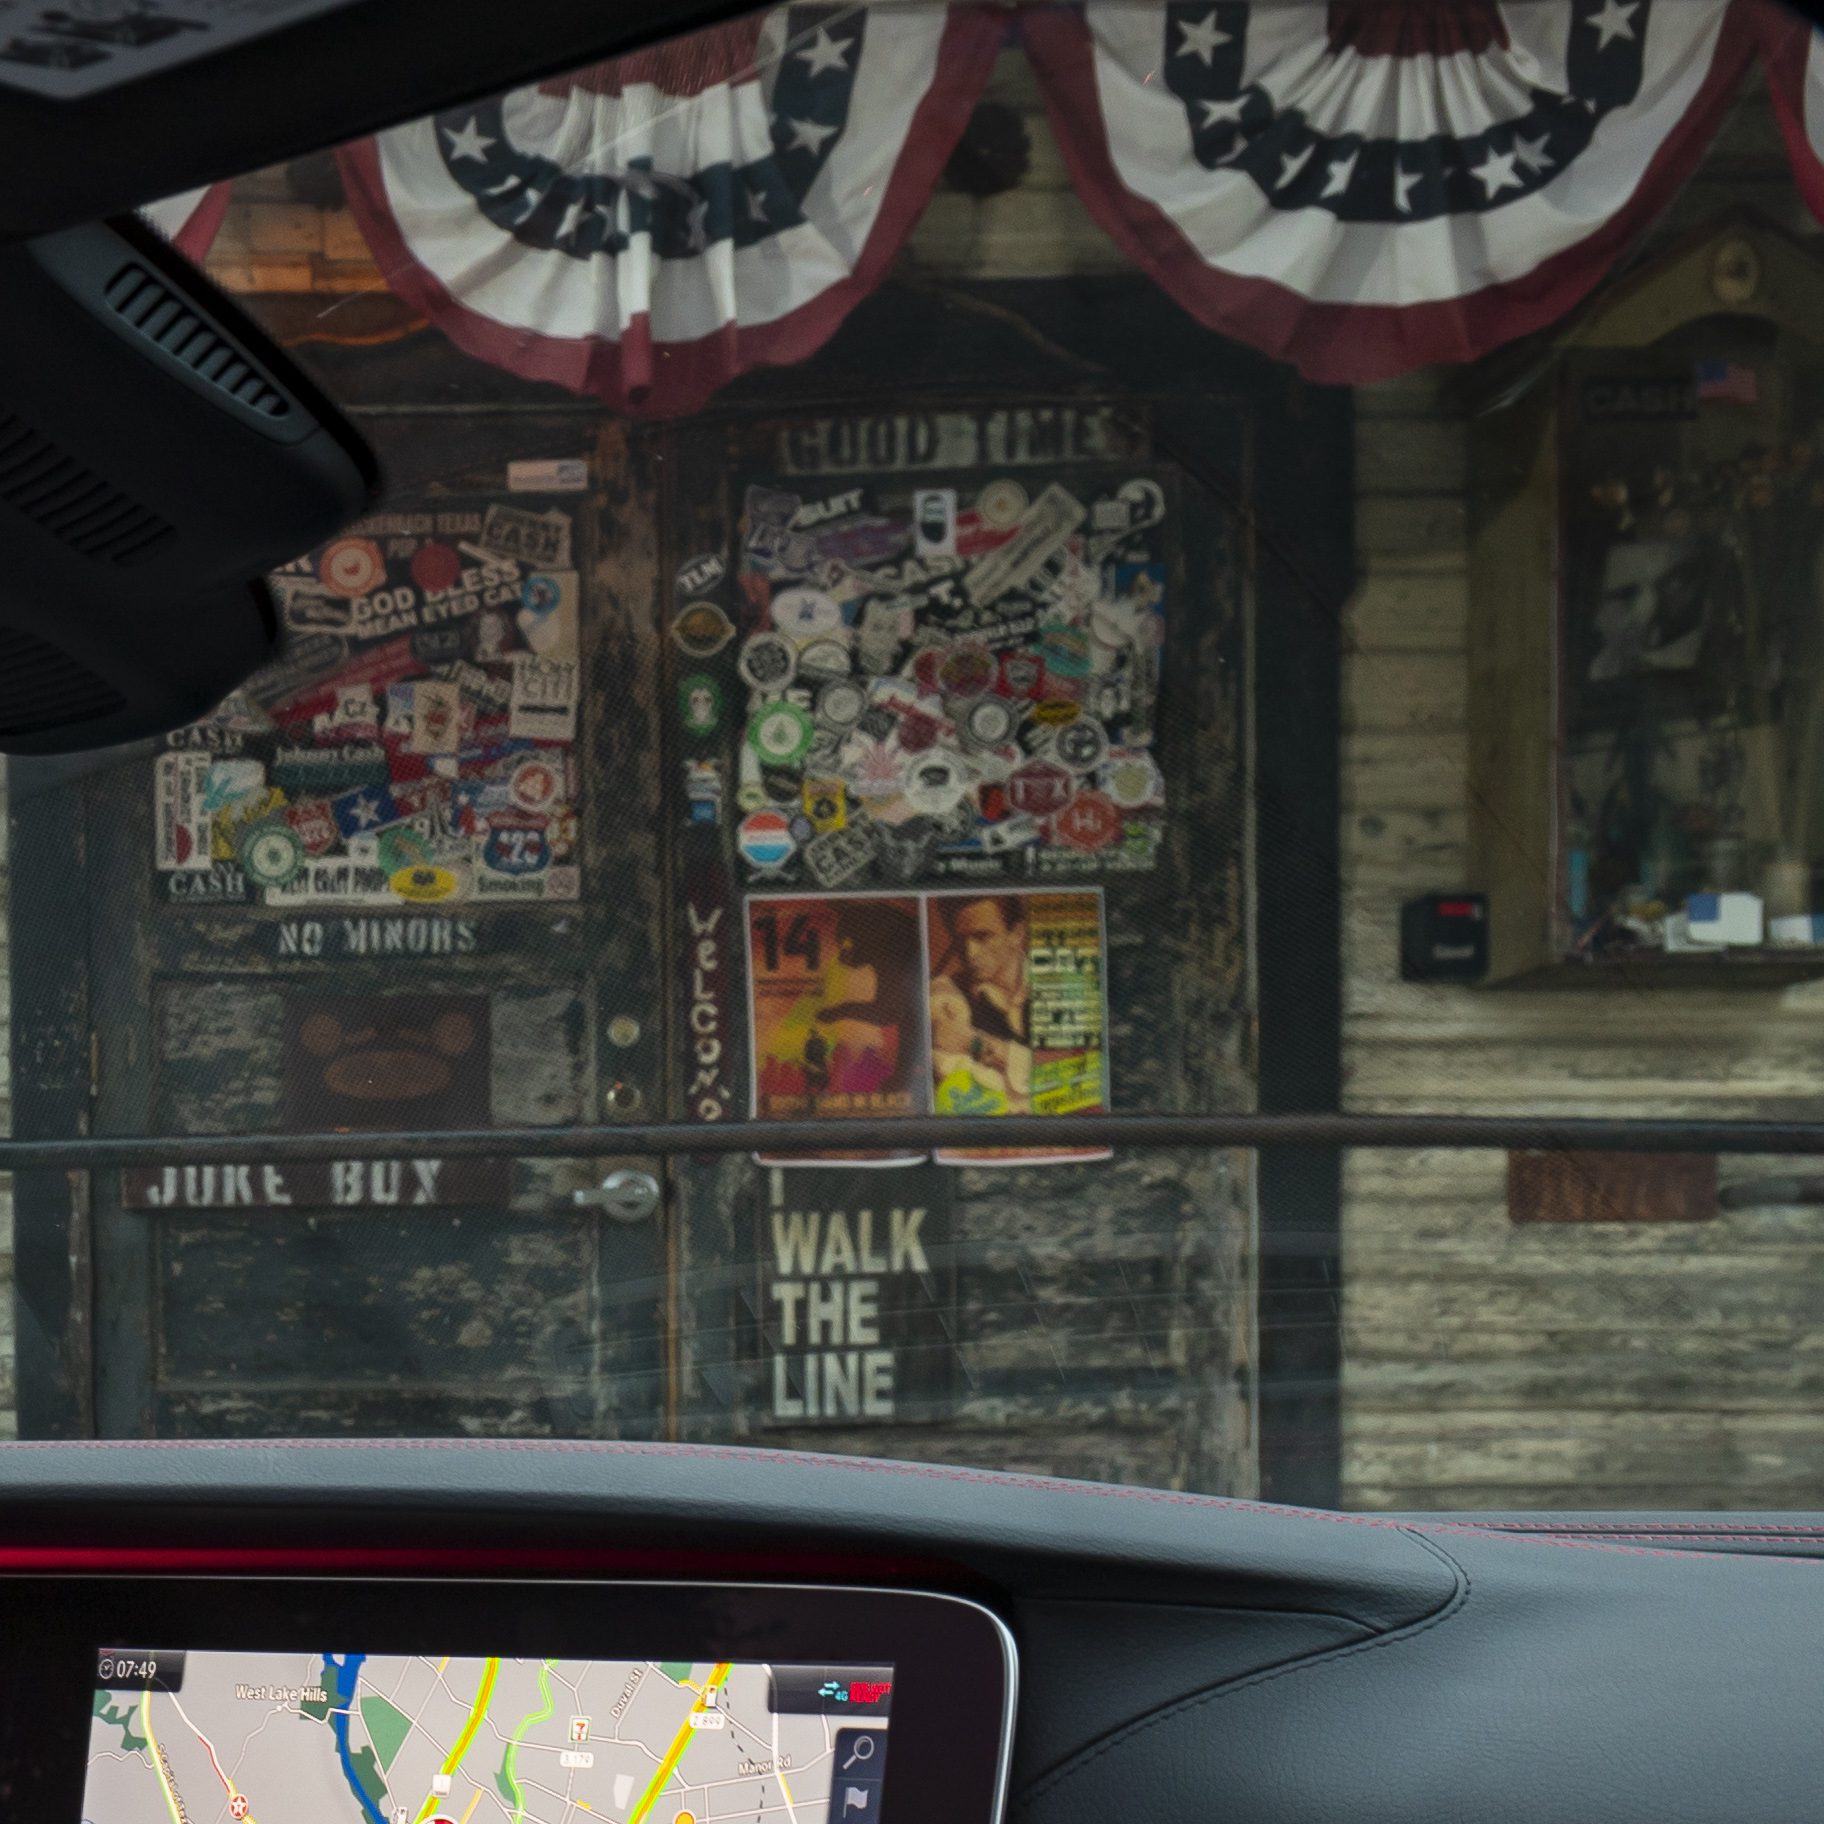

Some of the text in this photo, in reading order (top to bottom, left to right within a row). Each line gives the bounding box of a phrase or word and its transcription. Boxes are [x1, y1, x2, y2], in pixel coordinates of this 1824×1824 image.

[352, 587, 415, 620] GOD
[279, 917, 476, 956] NO MINORS
[330, 1159, 443, 1205] BOX
[771, 1207, 930, 1276] WALK
[772, 1280, 881, 1346] THE
[773, 1350, 896, 1418] LINE
[116, 1660, 157, 1680] 07:49
[235, 1684, 328, 1703] West Lake Hills
[738, 1753, 792, 1777] Manor Rd
